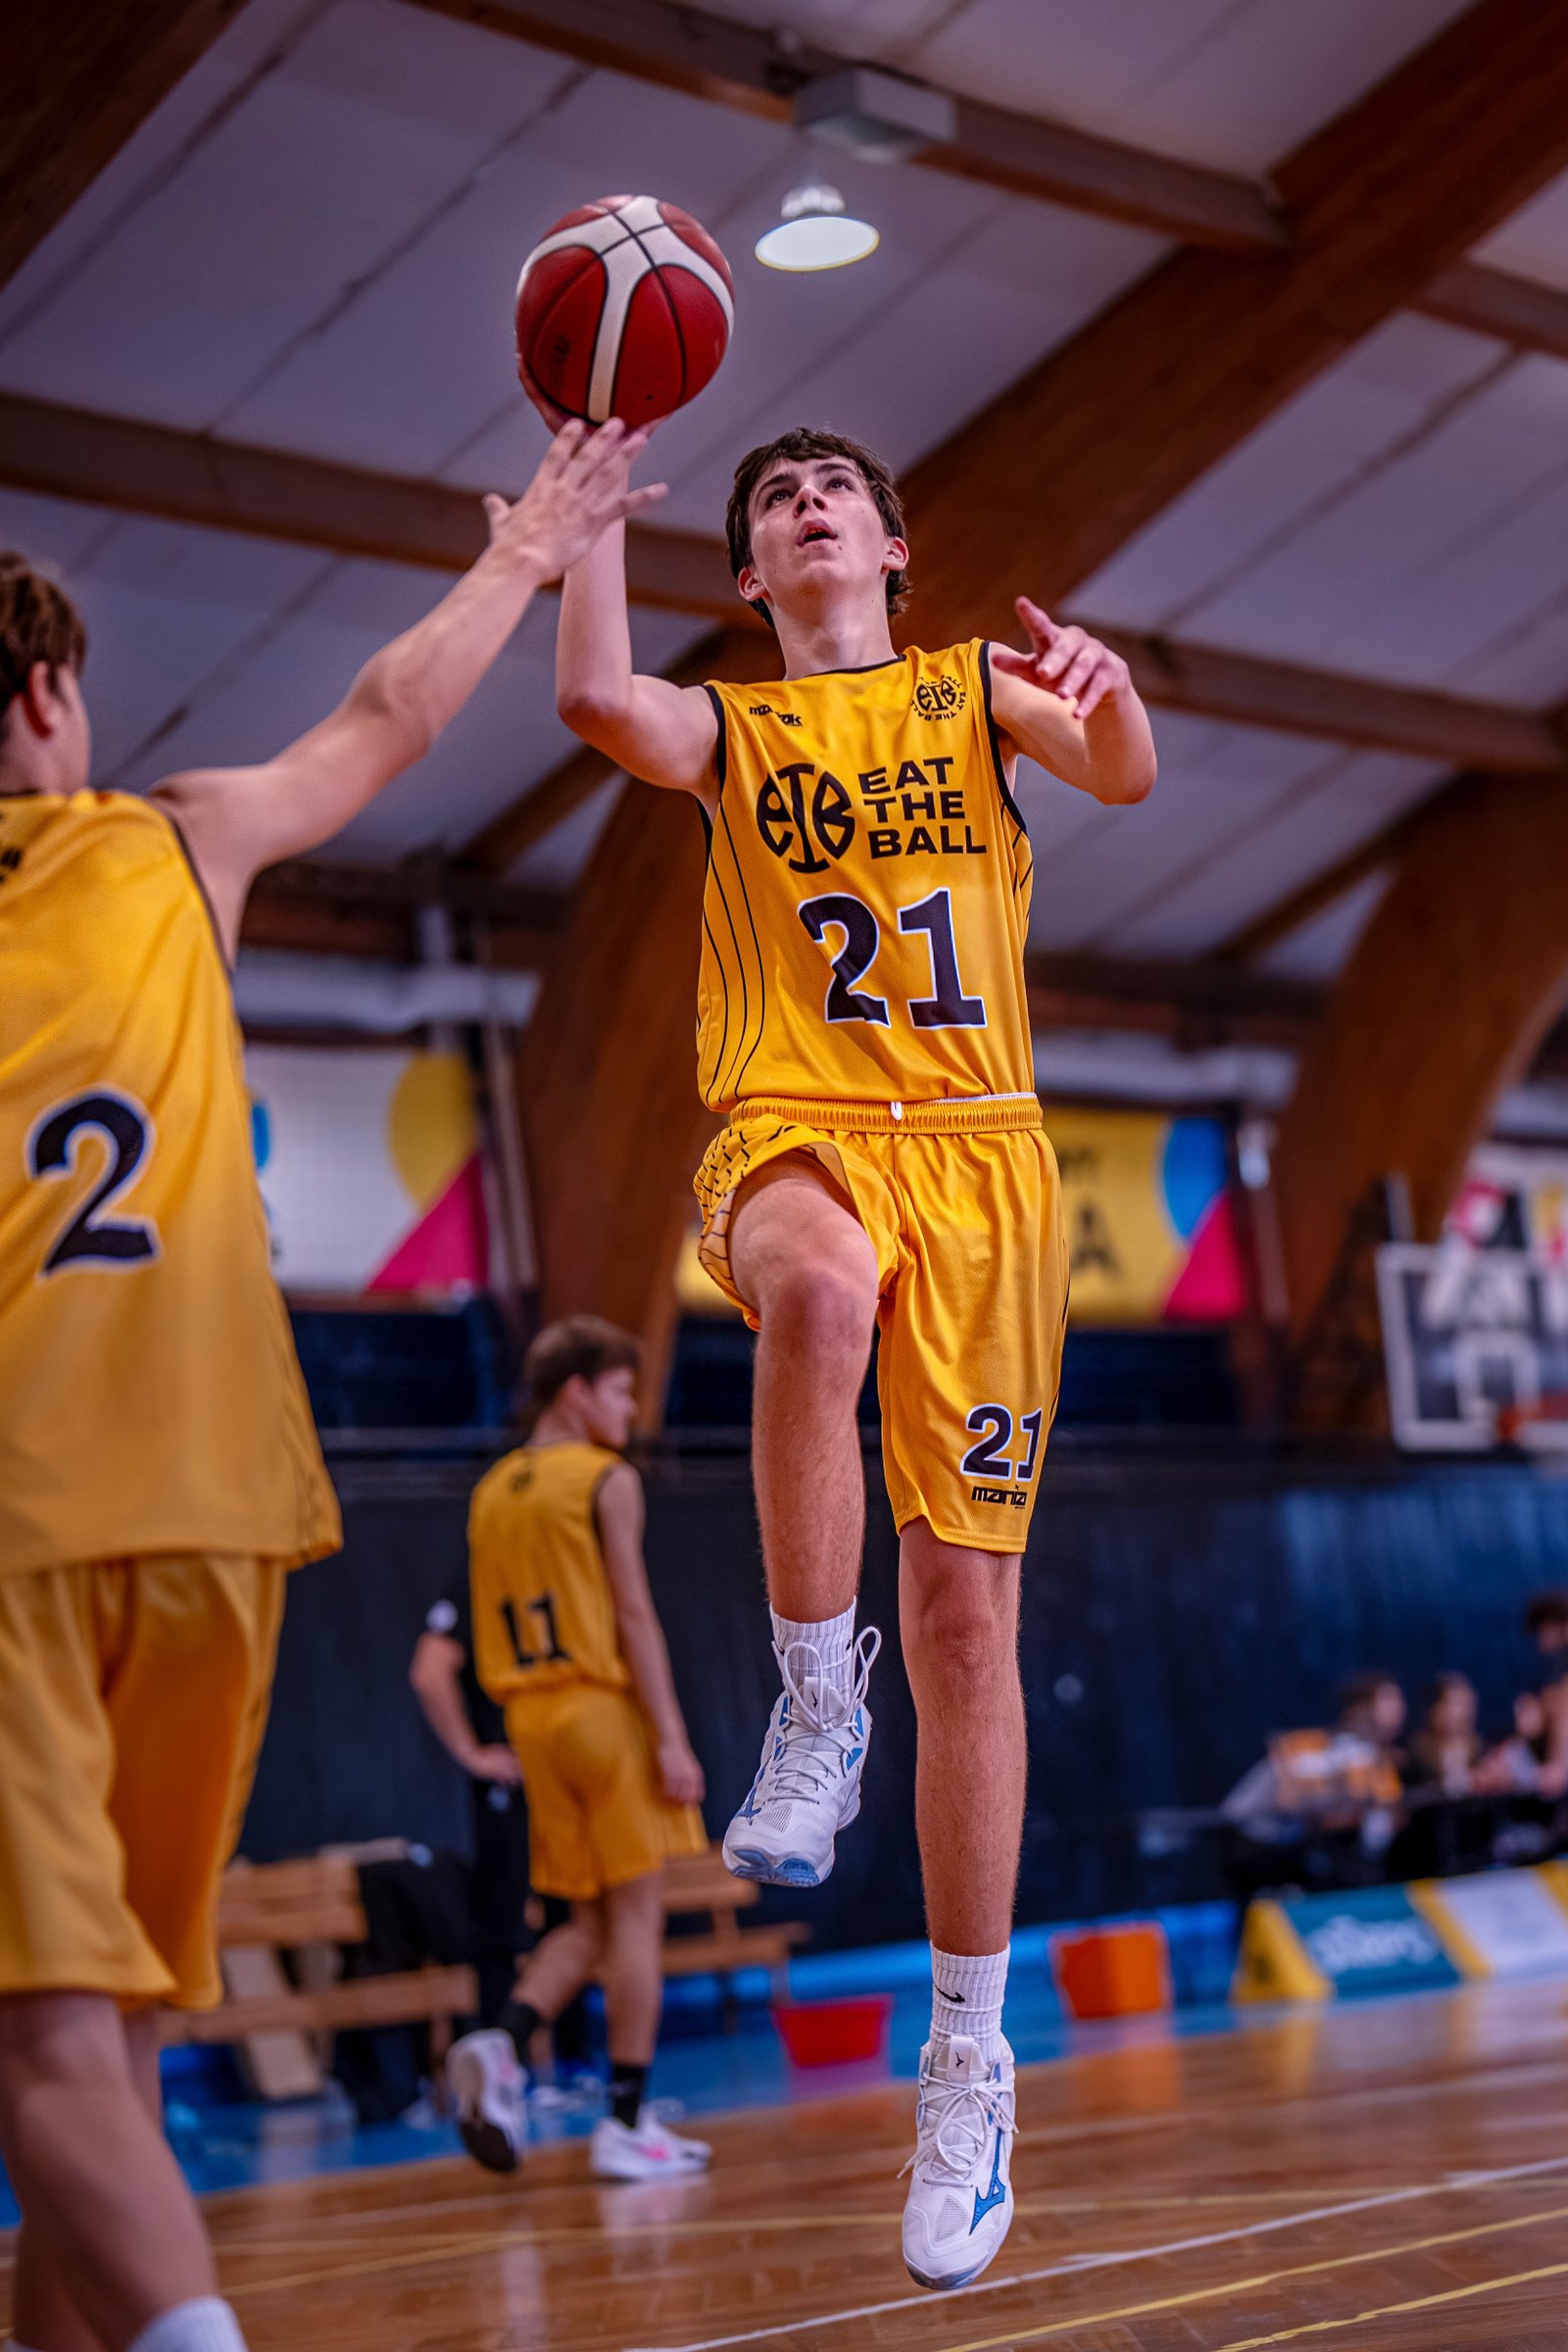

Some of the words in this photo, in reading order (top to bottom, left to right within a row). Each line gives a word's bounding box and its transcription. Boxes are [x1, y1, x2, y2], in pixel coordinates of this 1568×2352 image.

[858, 757, 954, 795] EAT
[863, 790, 966, 823] THE
[867, 825, 988, 859] BALL
[797, 886, 988, 1029] 21
[25, 1084, 163, 1276] 2
[960, 1402, 1043, 1482] 21
